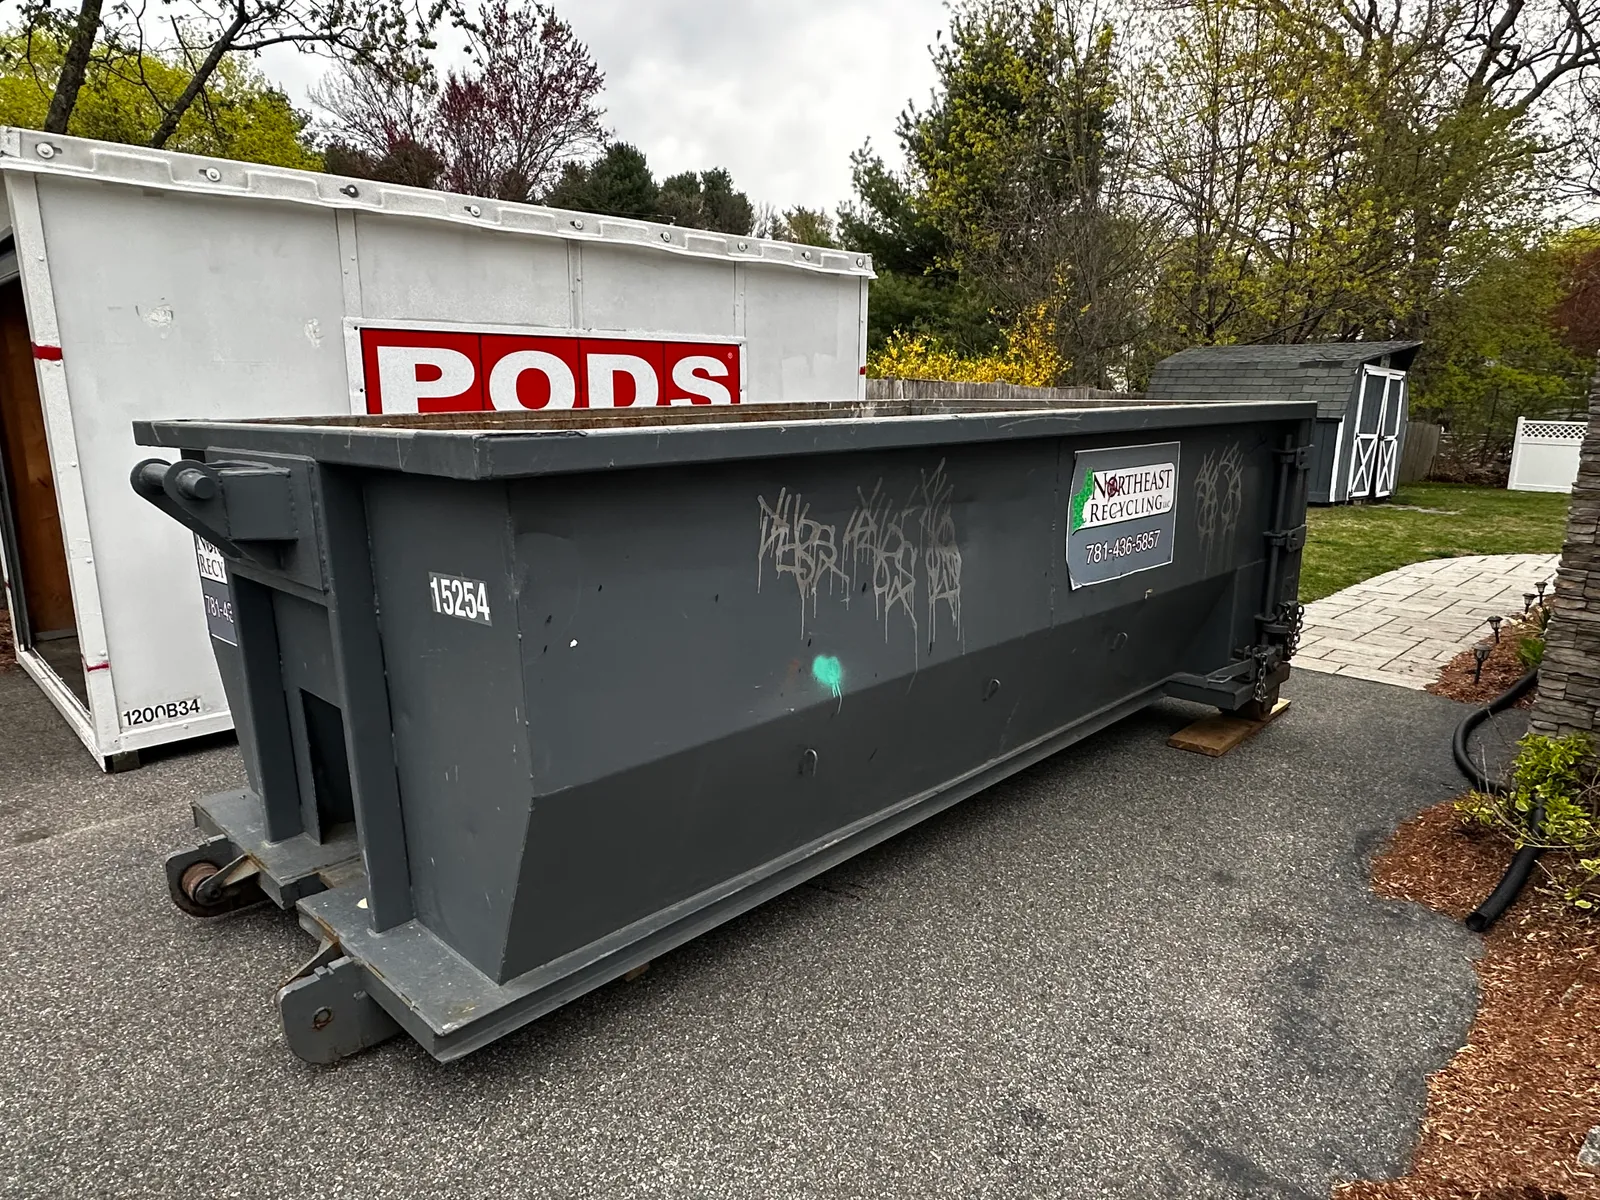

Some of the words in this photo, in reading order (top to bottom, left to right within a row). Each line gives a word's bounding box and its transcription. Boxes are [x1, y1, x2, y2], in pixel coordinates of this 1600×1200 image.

[1091, 469, 1173, 501] NORTHEAST
[1090, 495, 1163, 523] RECYCLING
[1086, 530, 1161, 564] 781-436-5857
[199, 554, 225, 579] RECY
[430, 576, 490, 621] 15254
[123, 699, 200, 726] 1200B34
